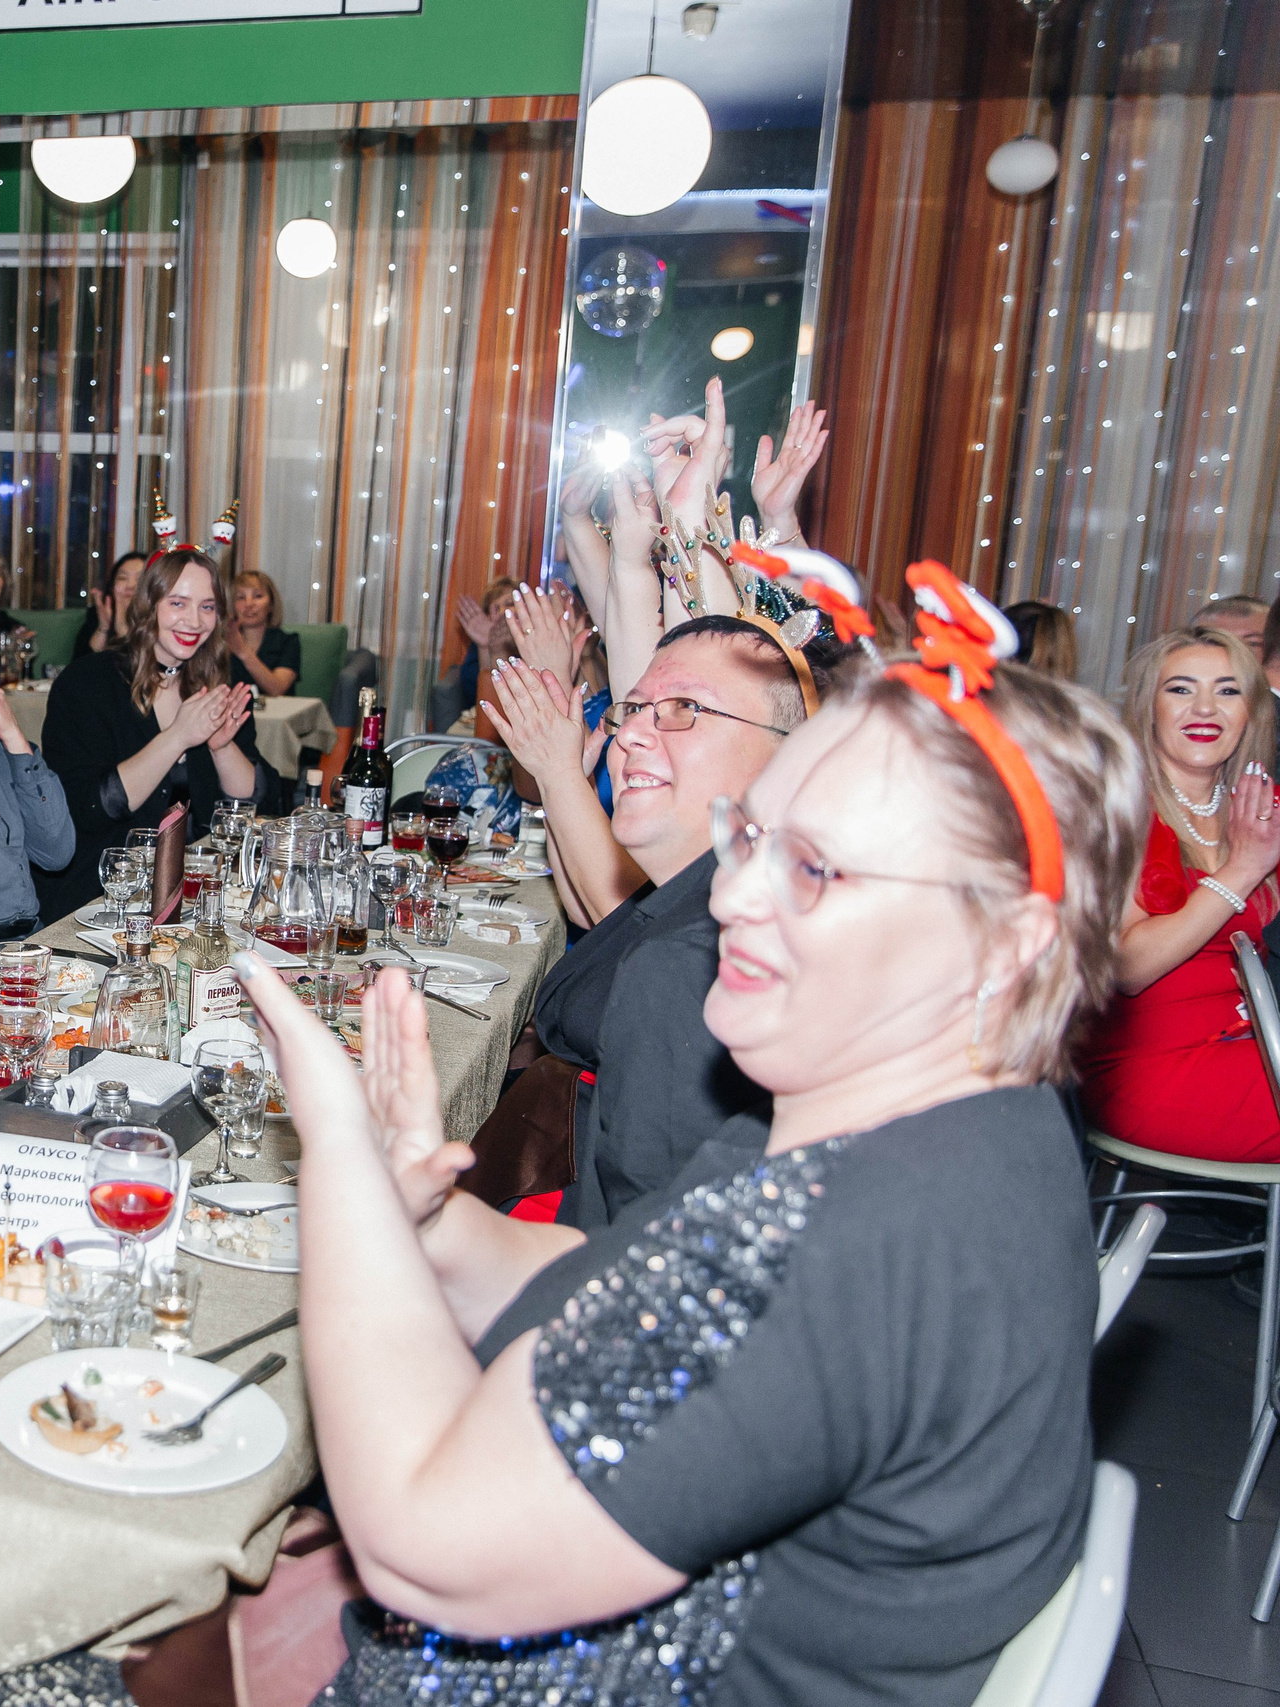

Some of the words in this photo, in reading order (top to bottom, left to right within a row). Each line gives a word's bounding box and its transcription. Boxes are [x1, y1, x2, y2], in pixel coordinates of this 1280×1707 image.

[208, 984, 240, 999] ПЕРВАКЪ
[18, 1144, 77, 1160] ОГАУСО
[0, 1163, 87, 1183] Марковски
